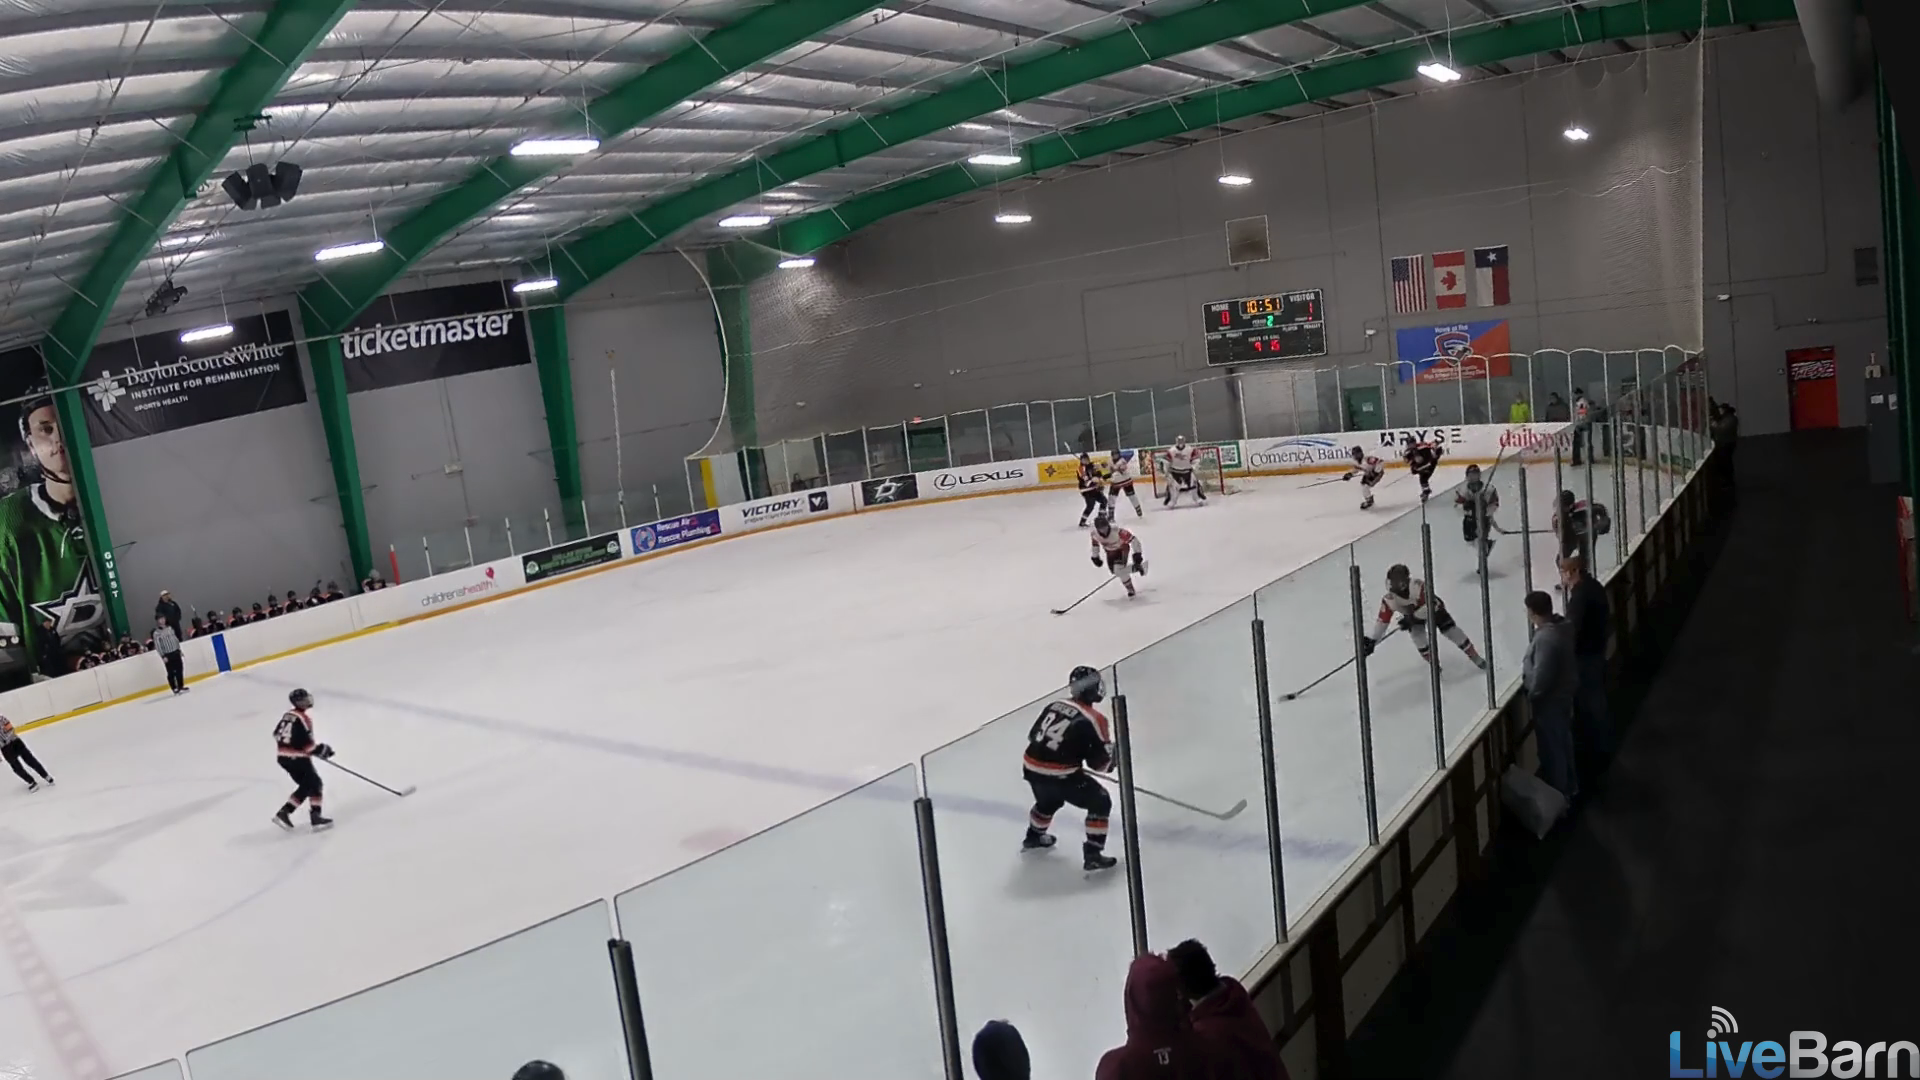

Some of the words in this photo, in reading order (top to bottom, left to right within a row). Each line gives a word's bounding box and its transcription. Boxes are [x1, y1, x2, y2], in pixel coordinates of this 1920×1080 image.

[1246, 298, 1280, 313] 10:51
[1221, 310, 1230, 326] 0
[340, 313, 513, 359] ticketmaster
[131, 384, 181, 400] INSTITUTE
[183, 377, 203, 389] FOR
[205, 363, 281, 386] REHABILITATION
[162, 395, 189, 407] HEALTH
[1318, 446, 1352, 460] Bank
[959, 469, 1024, 484] LEXUS
[741, 499, 800, 518] VICTORY
[104, 551, 119, 598] GUEST
[1036, 711, 1071, 751] 94
[1157, 1052, 1170, 1065] 13
